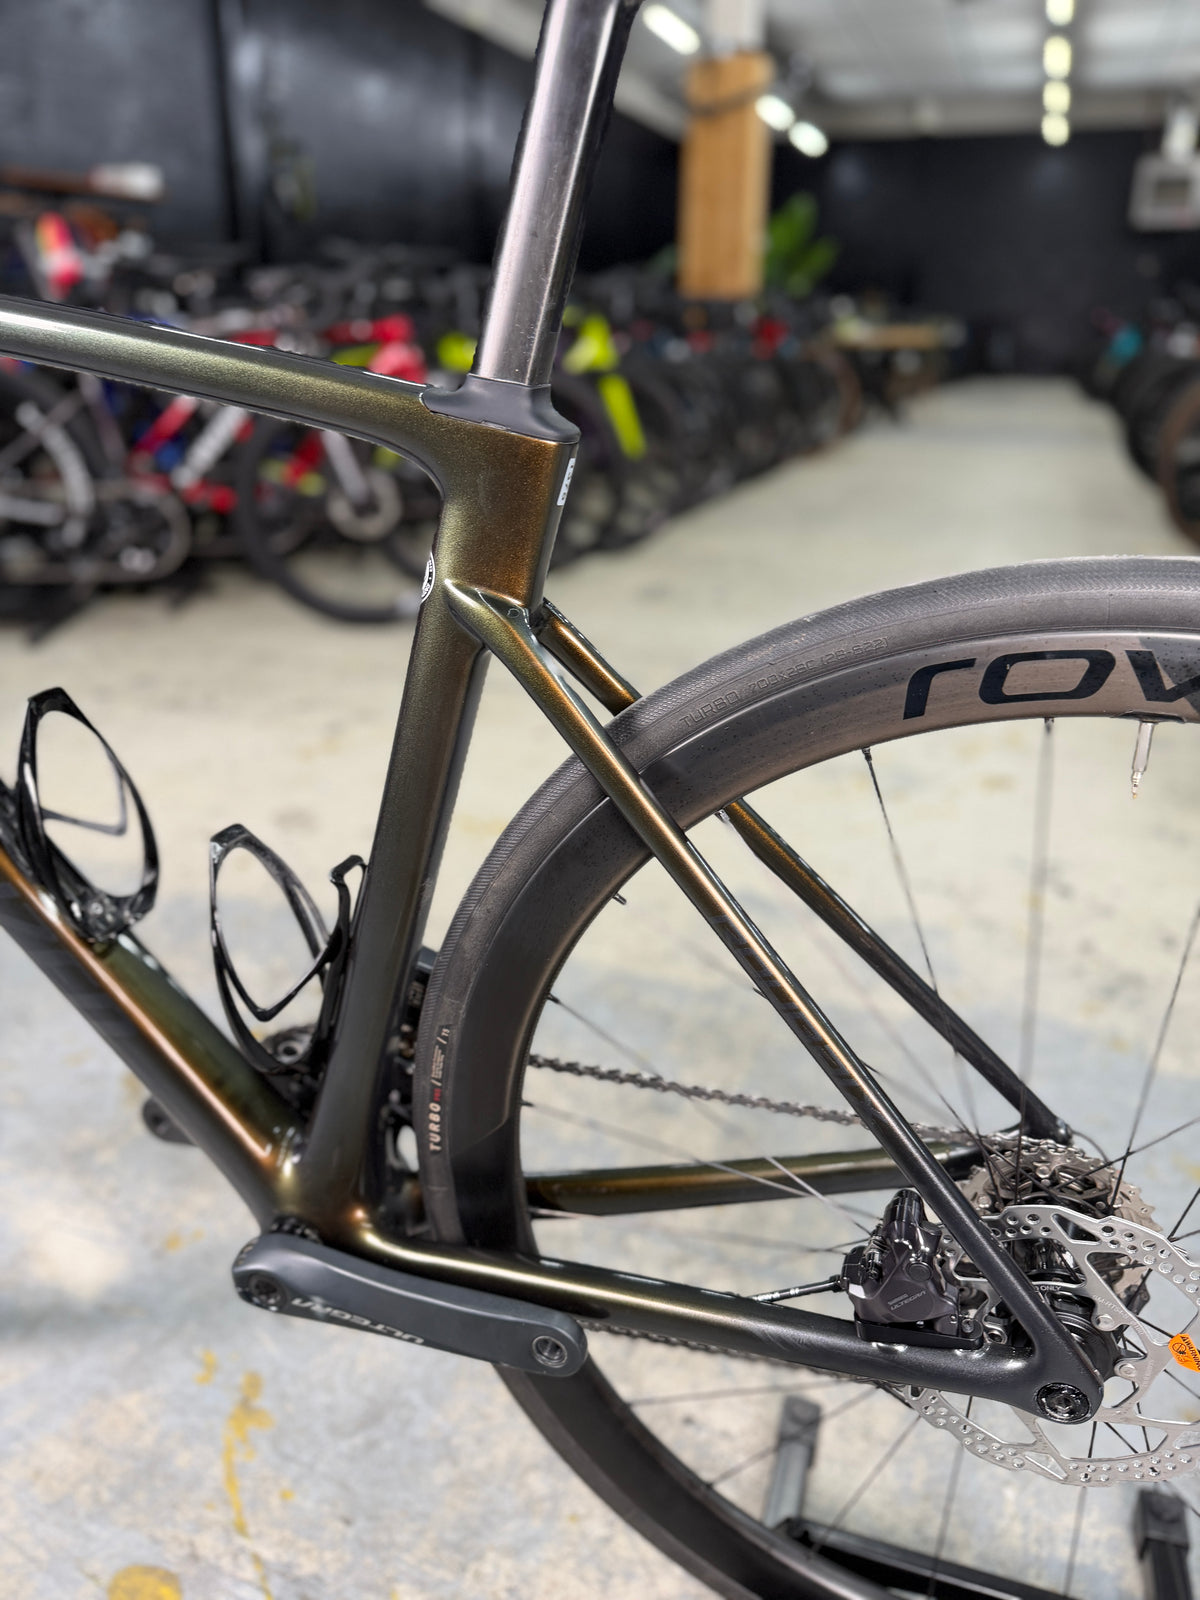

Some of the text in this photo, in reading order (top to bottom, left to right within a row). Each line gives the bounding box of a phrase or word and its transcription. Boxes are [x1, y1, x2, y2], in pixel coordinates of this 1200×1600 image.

[679, 690, 740, 728] TURBO
[429, 1102, 442, 1151] TURBO
[291, 1297, 425, 1344] ULTEGRA
